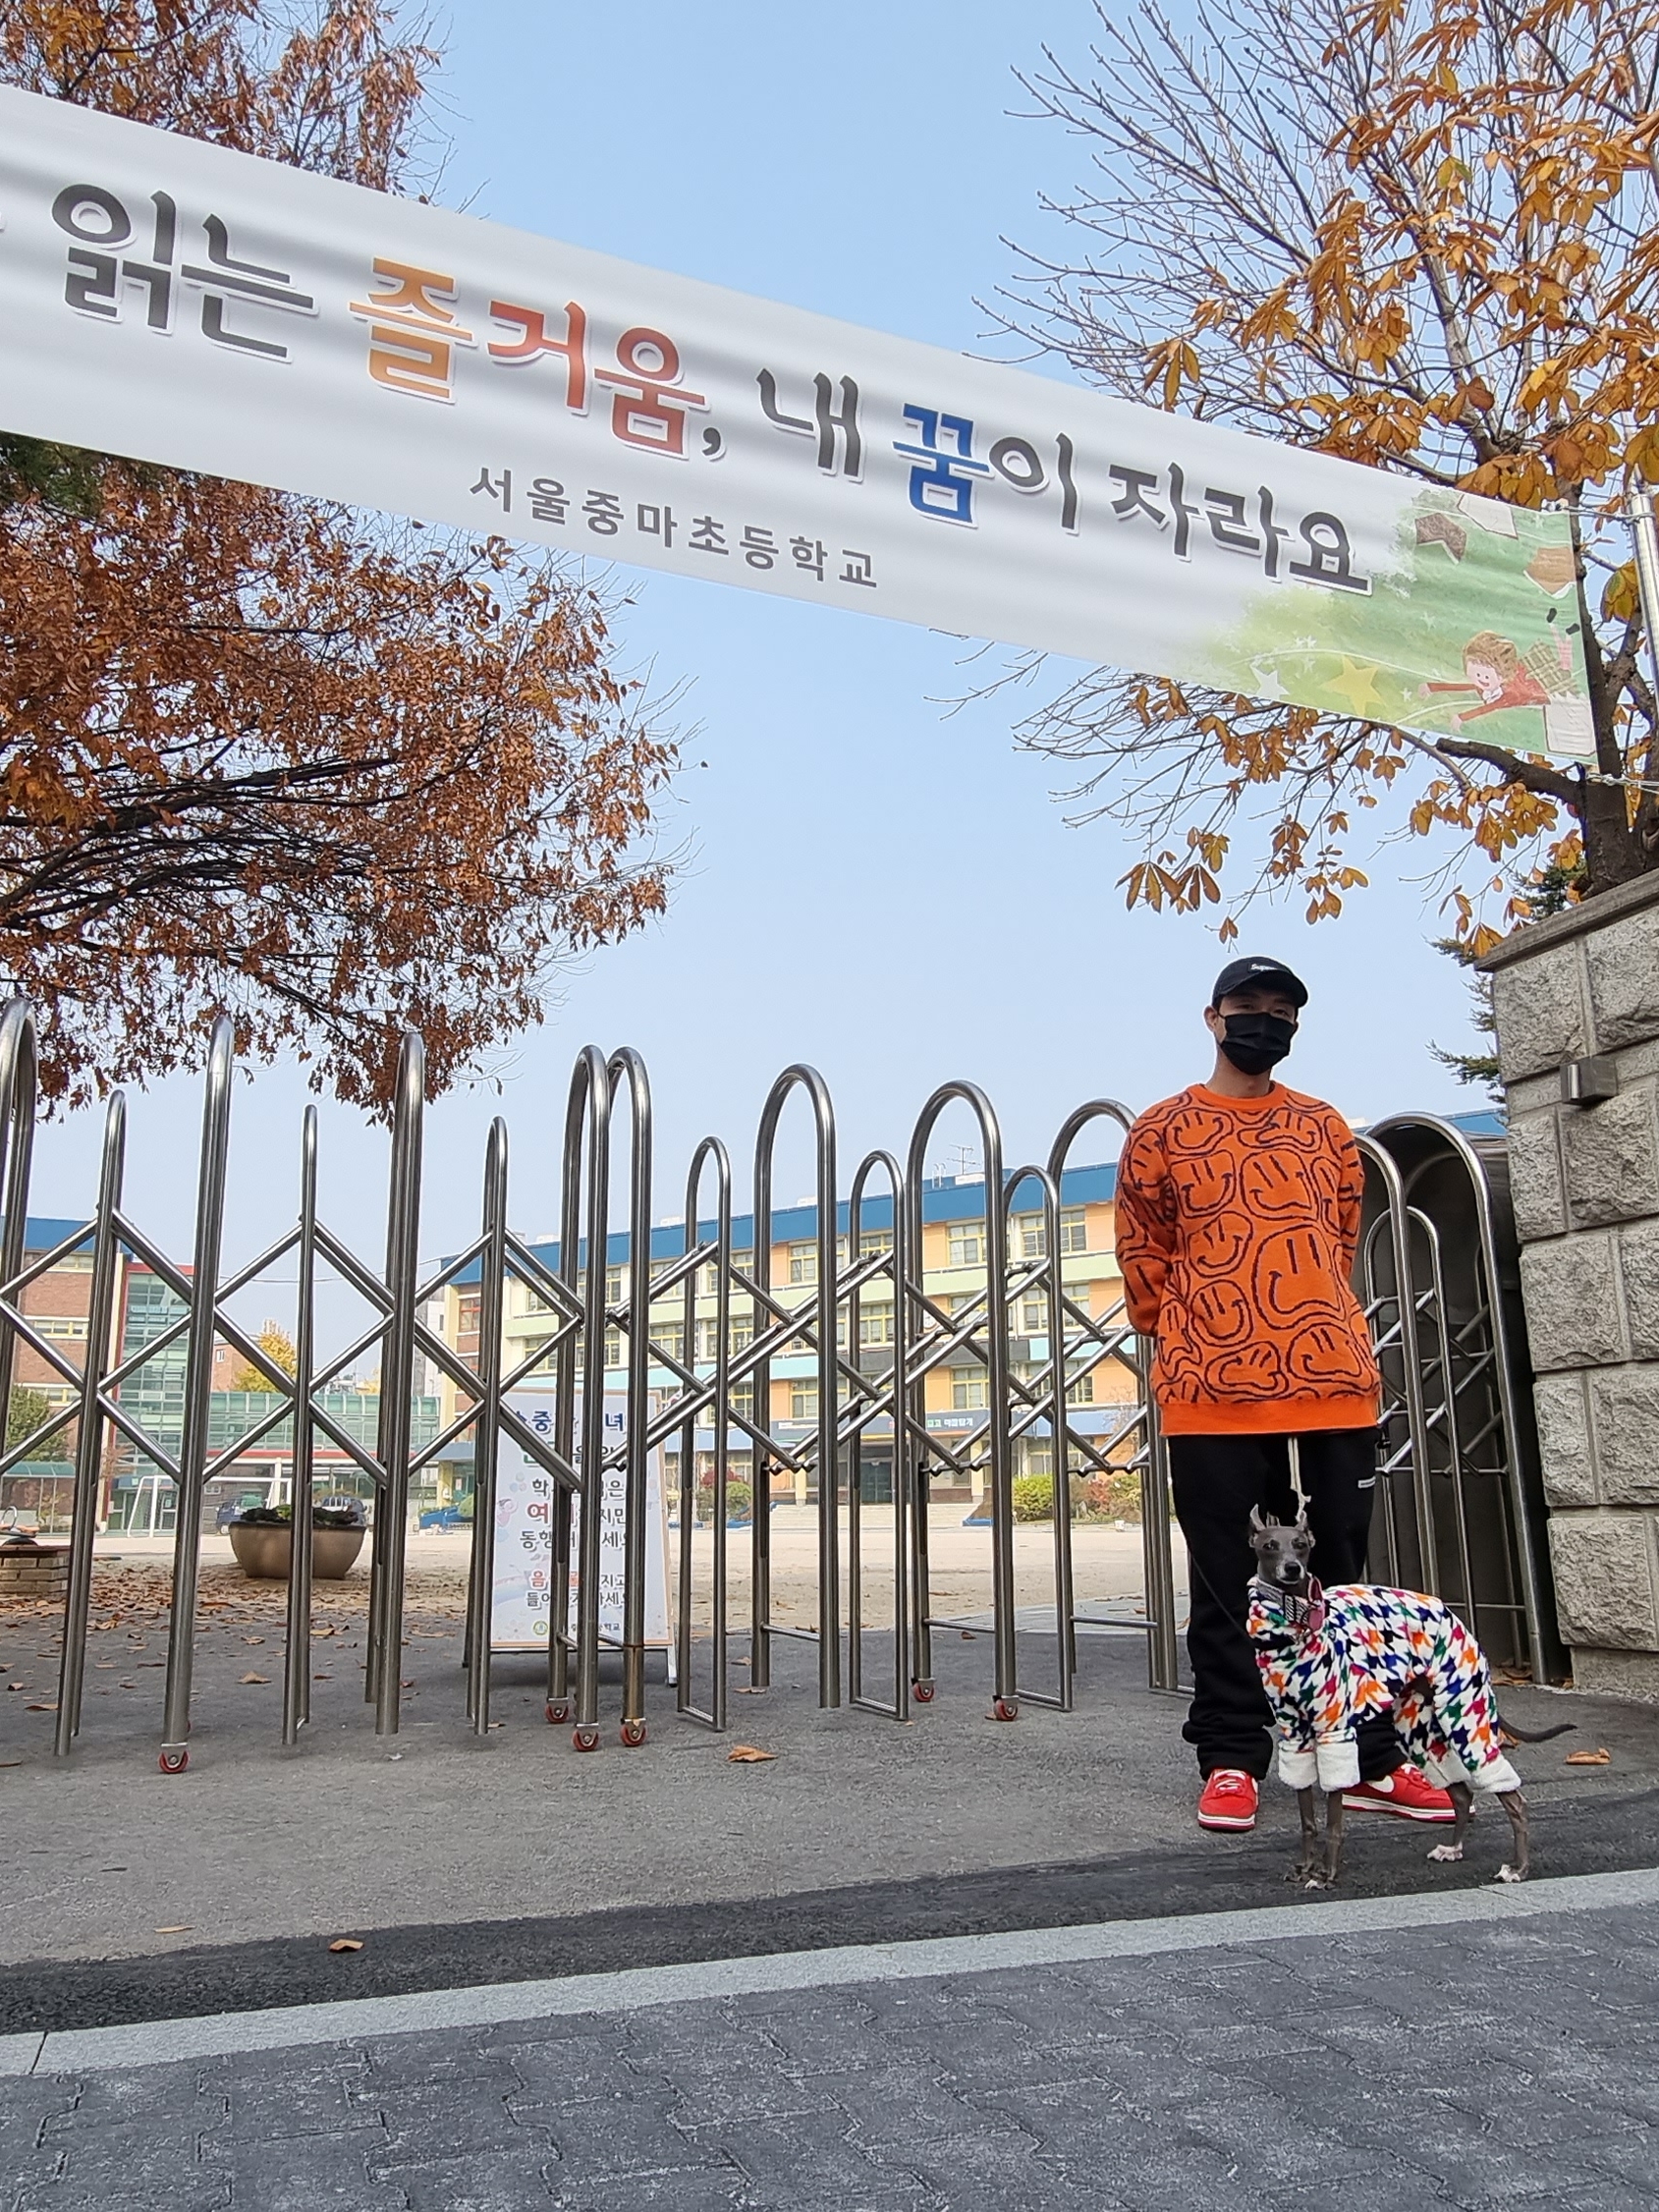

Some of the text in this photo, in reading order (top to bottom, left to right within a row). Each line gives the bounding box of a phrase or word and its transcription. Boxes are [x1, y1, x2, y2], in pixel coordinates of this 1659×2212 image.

[51, 184, 1369, 590] 읽는 즐거움, 내 꿈이 자라요
[470, 467, 877, 588] 서울중마초등학교
